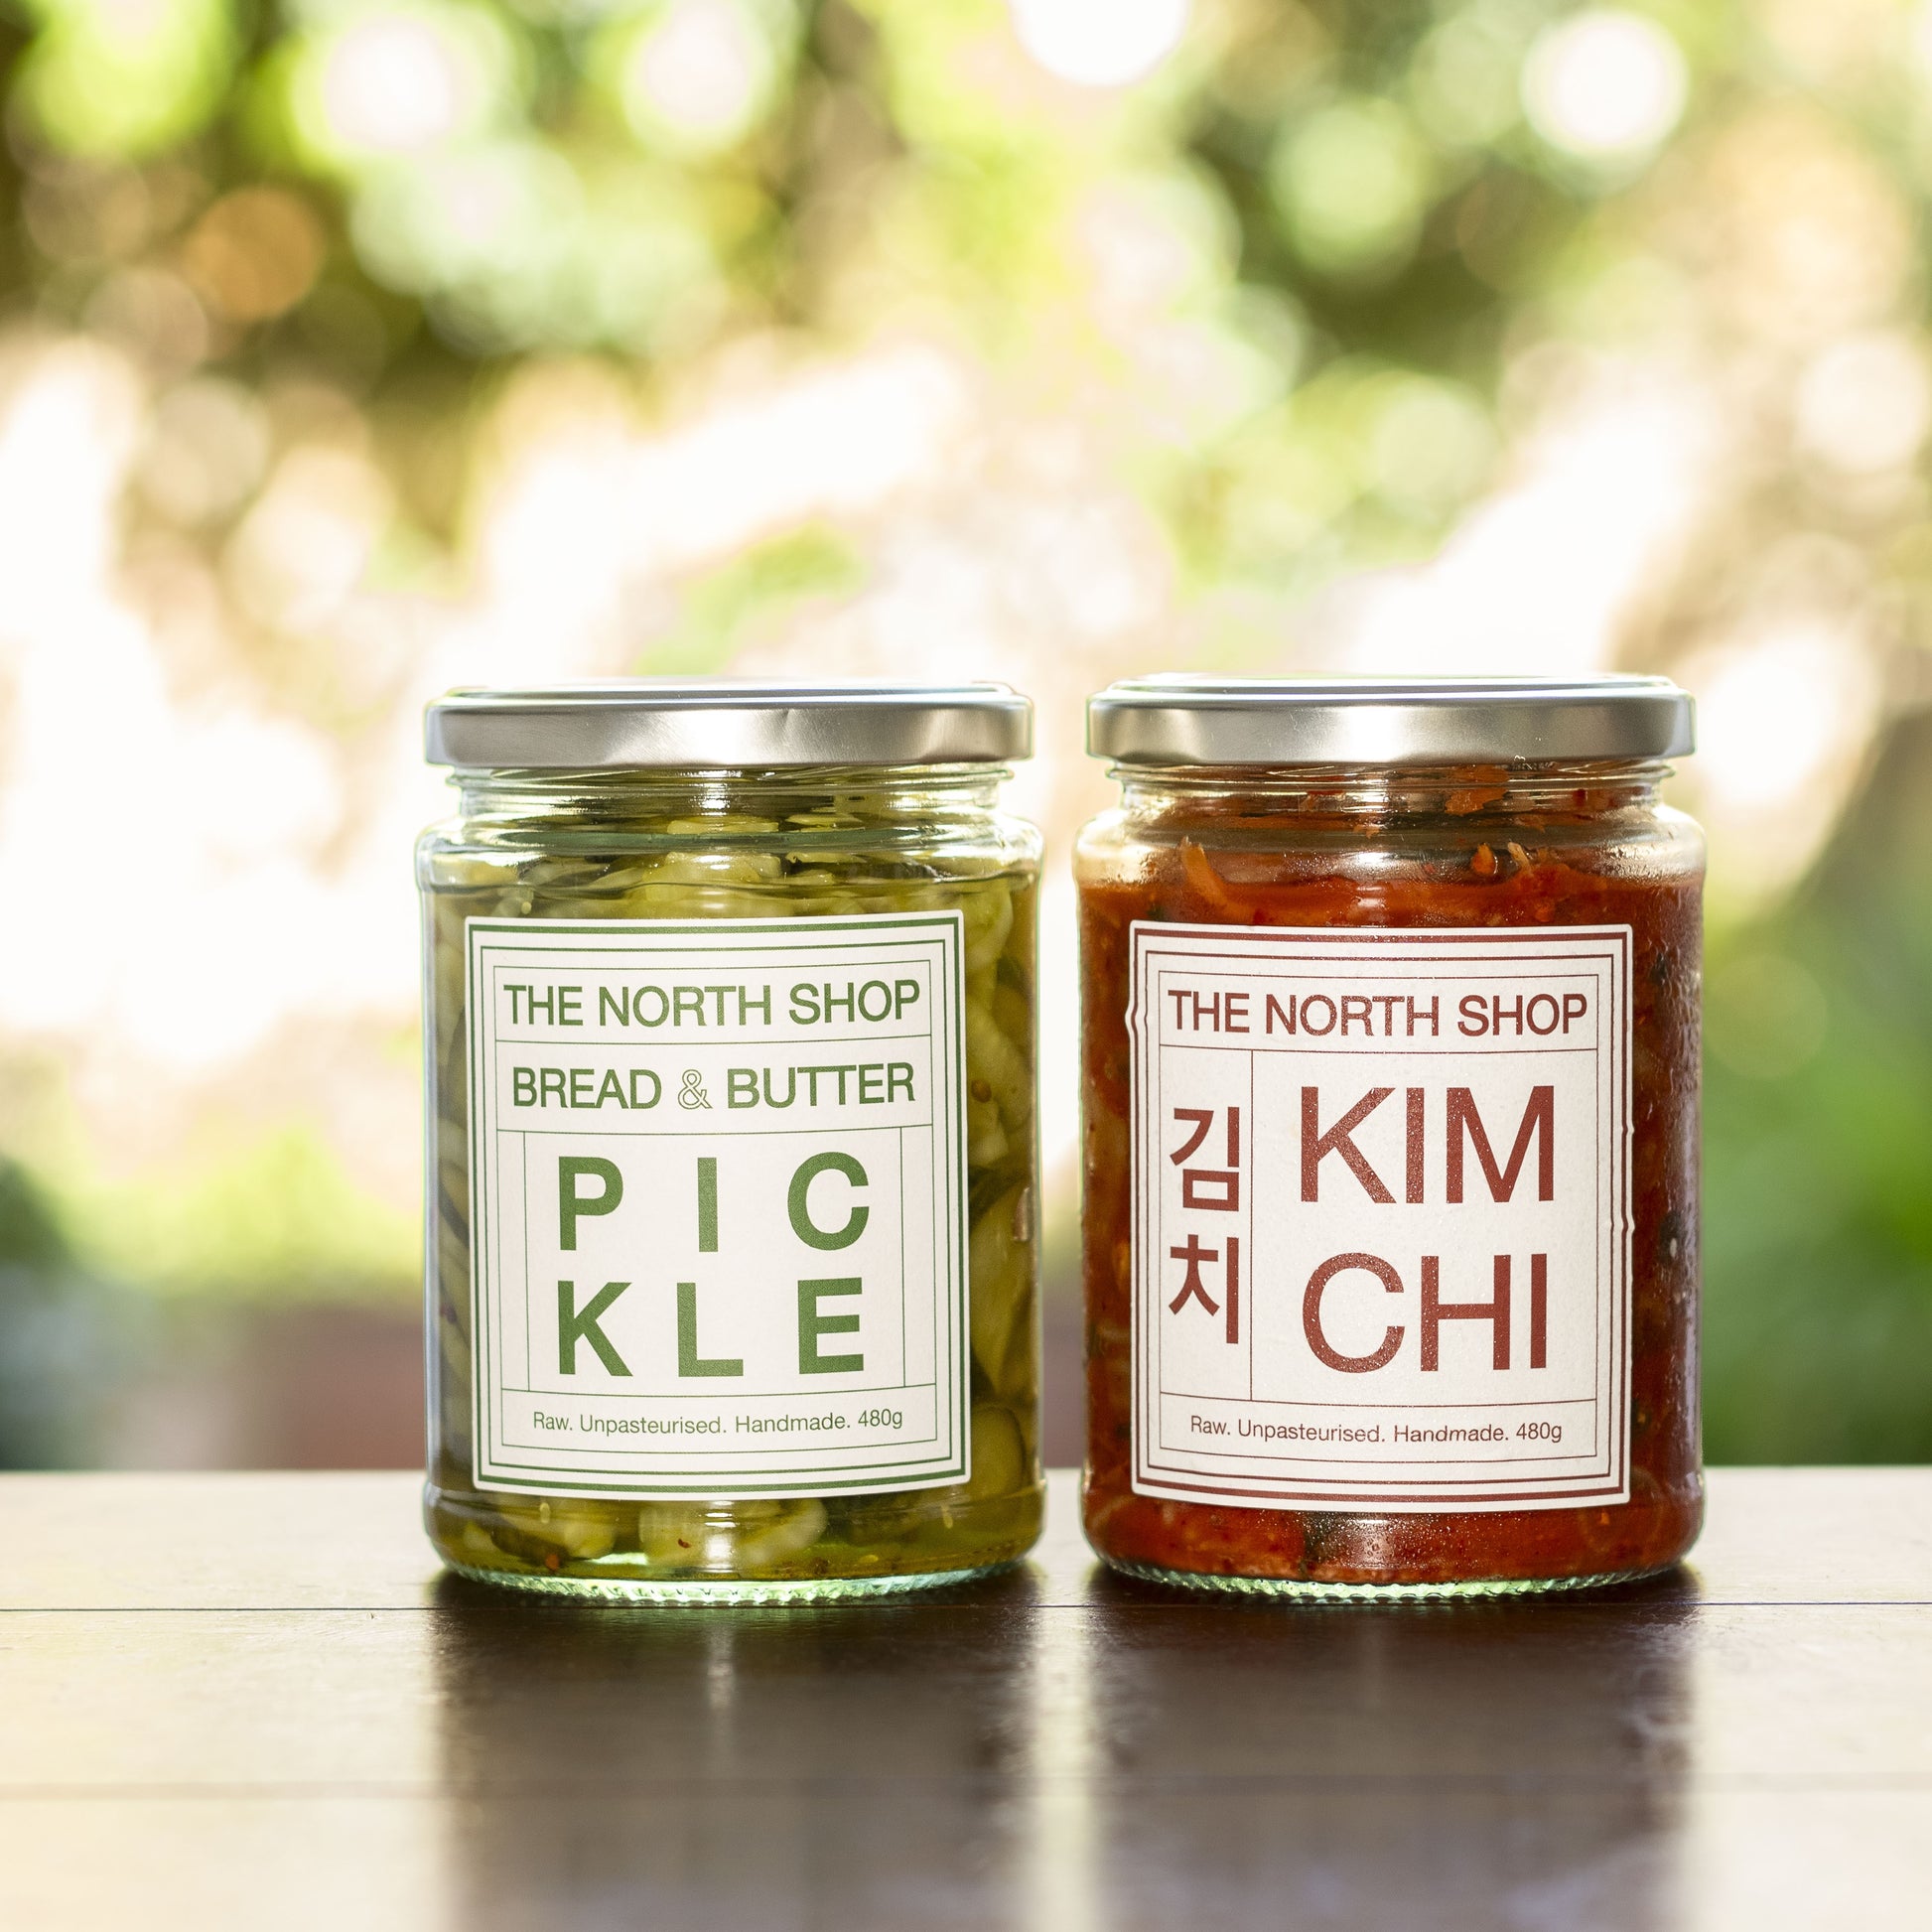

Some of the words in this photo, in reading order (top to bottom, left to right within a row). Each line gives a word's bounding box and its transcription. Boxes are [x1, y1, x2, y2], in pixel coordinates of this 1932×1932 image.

[504, 985, 583, 1026] THE
[600, 986, 770, 1027] NORTH
[789, 980, 919, 1025] SHOP
[1169, 990, 1249, 1033] THE
[1266, 994, 1439, 1036] NORTH
[1458, 994, 1587, 1036] SHOP
[513, 1067, 661, 1109] BREAD
[678, 1070, 712, 1109] &
[728, 1062, 914, 1108] BUTTER
[1301, 1086, 1554, 1203] KIM
[1169, 1107, 1239, 1343] 김치
[1303, 1253, 1547, 1373] CHI
[534, 1412, 572, 1430] Raw.
[581, 1415, 726, 1436] Unpasteurised.
[737, 1413, 850, 1432] Handmade.
[859, 1409, 901, 1429] 480g
[1191, 1416, 1230, 1435] Raw.
[1239, 1420, 1384, 1442] Unpasteurised.
[1395, 1425, 1508, 1442] Handmade.
[1516, 1423, 1561, 1443] 480g
